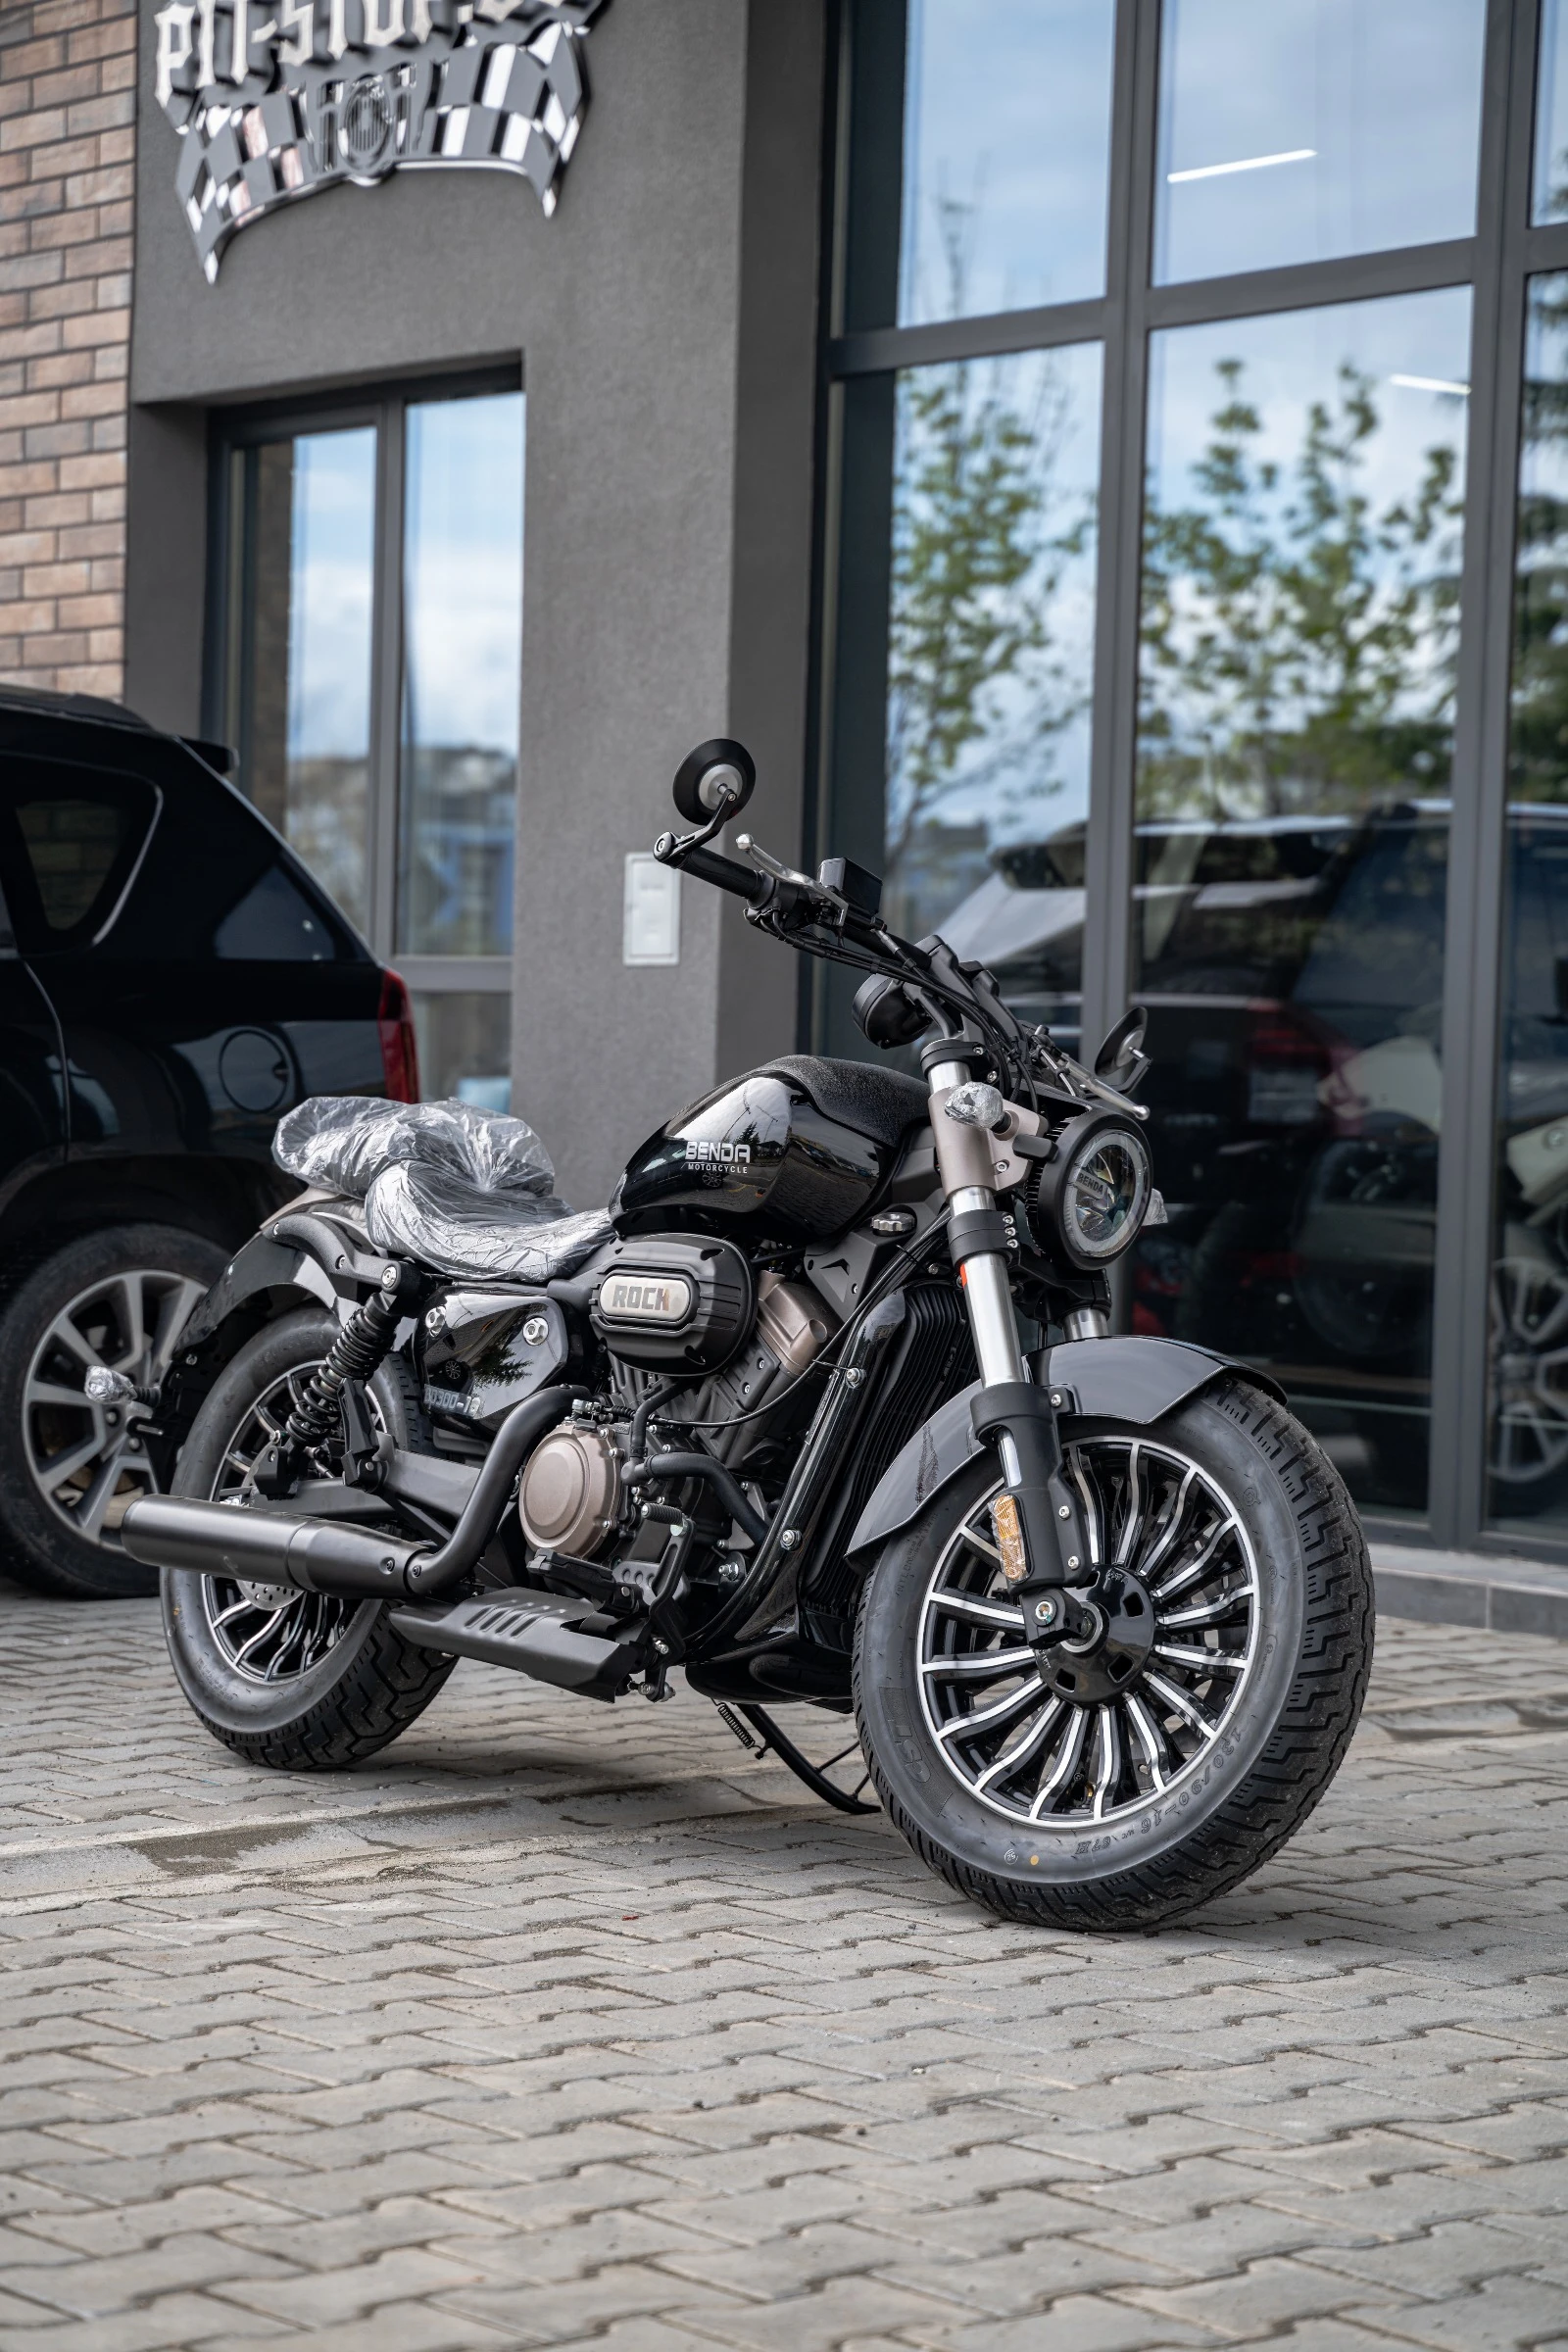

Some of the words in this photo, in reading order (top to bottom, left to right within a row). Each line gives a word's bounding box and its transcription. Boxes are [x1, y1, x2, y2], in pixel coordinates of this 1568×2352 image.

[685, 1141, 751, 1163] BENDA
[687, 1163, 748, 1174] MOTORCYCLE
[1078, 1173, 1103, 1194] BENDA
[612, 1285, 670, 1311] ROCK
